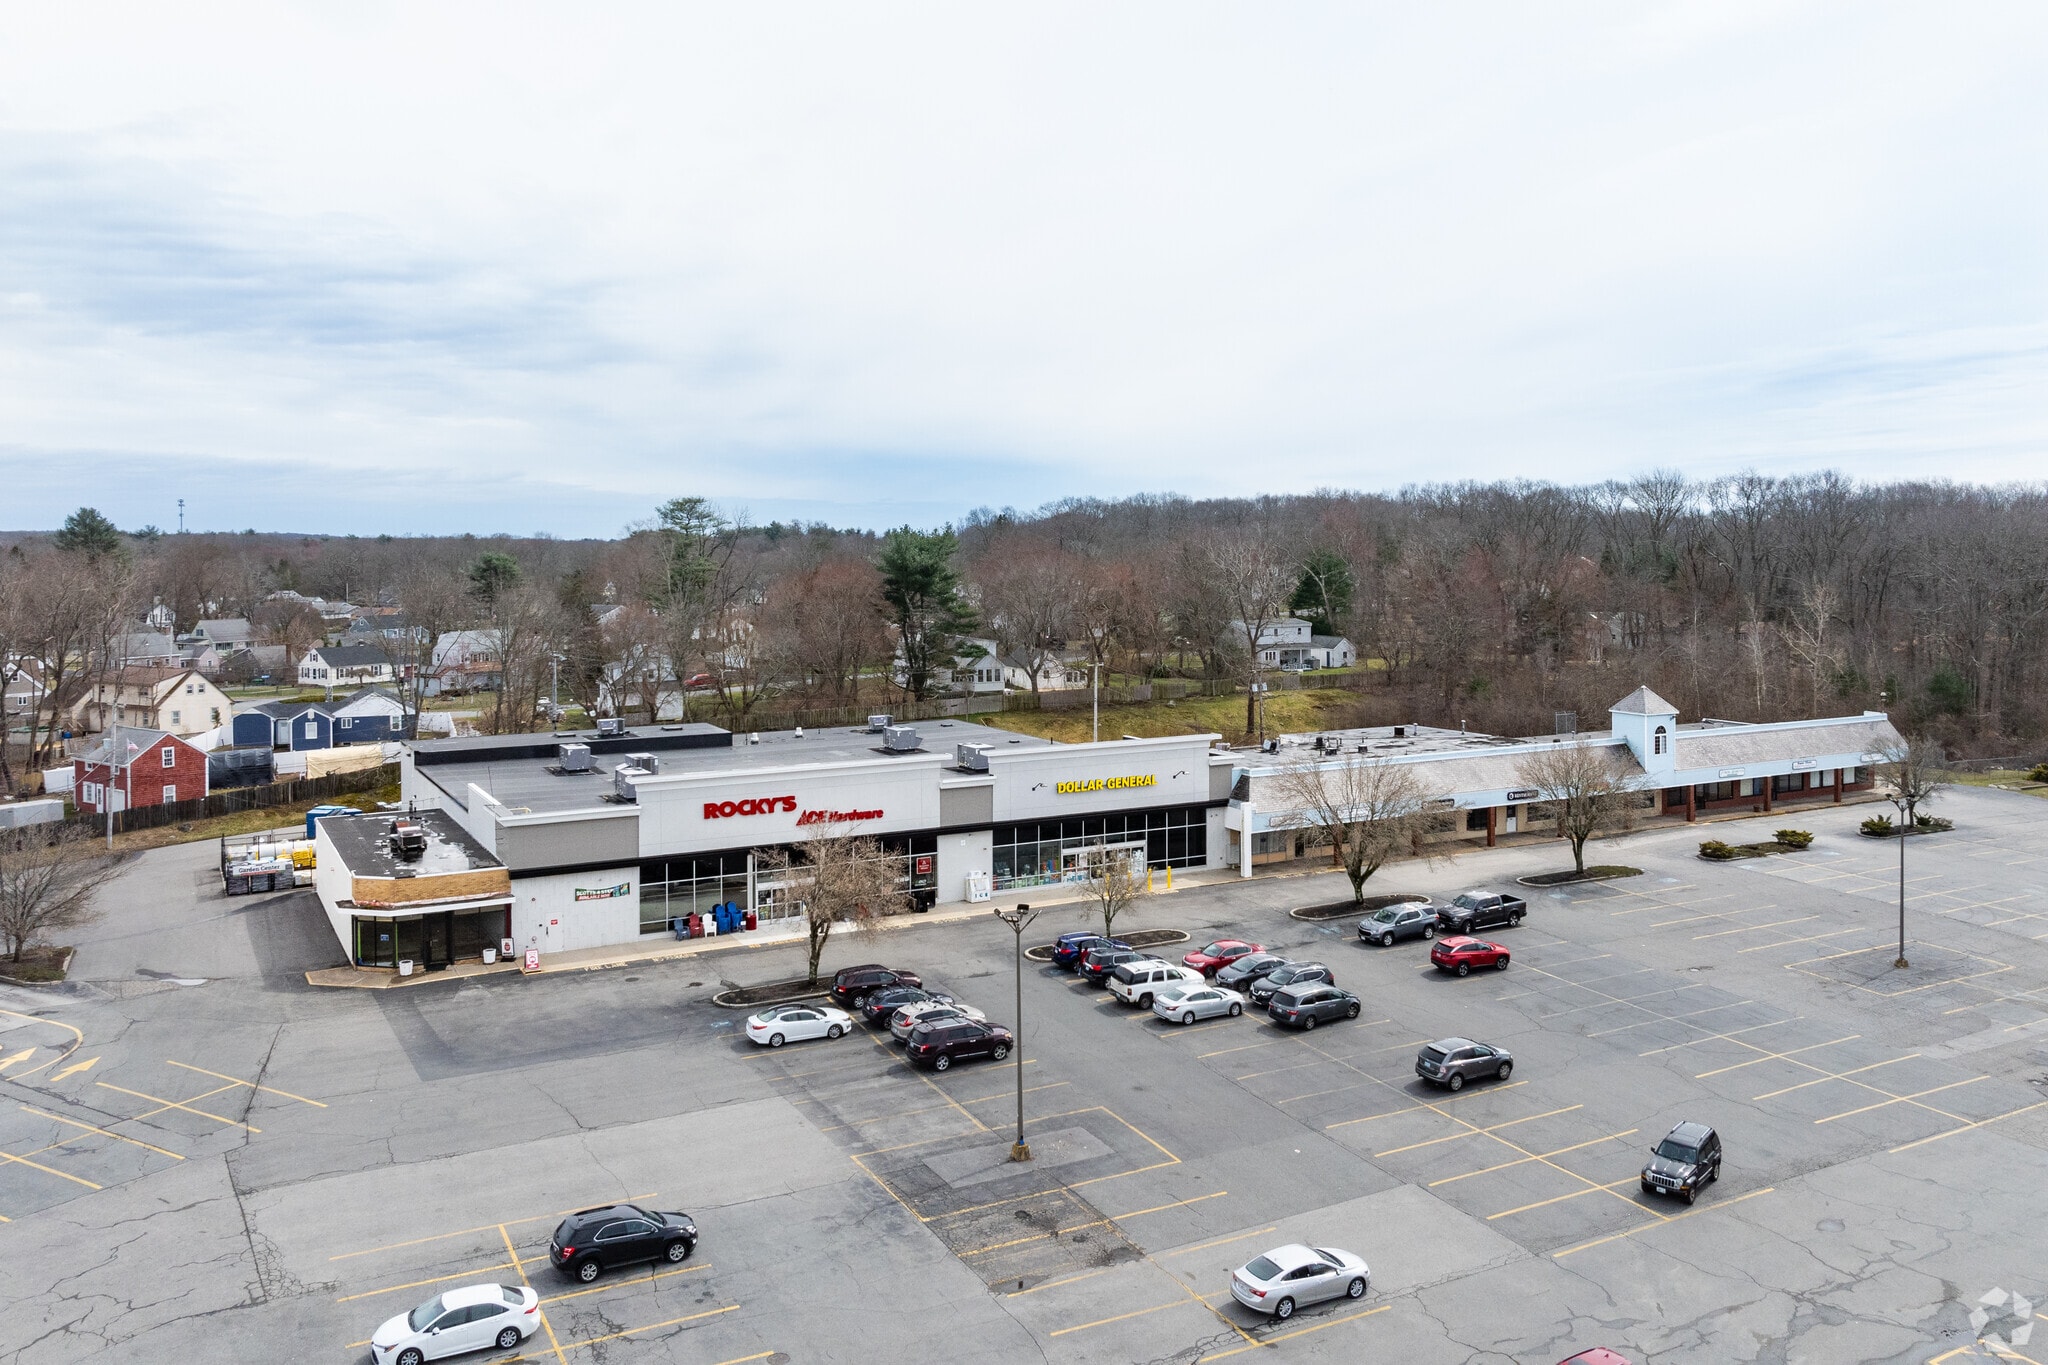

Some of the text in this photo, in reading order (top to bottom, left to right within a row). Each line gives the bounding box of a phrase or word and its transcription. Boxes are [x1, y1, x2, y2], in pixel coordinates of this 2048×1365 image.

[1057, 774, 1158, 794] DOLLAR GENERAL
[703, 795, 798, 820] ROCKY'S
[796, 808, 884, 827] ACE Hardware
[238, 864, 281, 874] Garden Center
